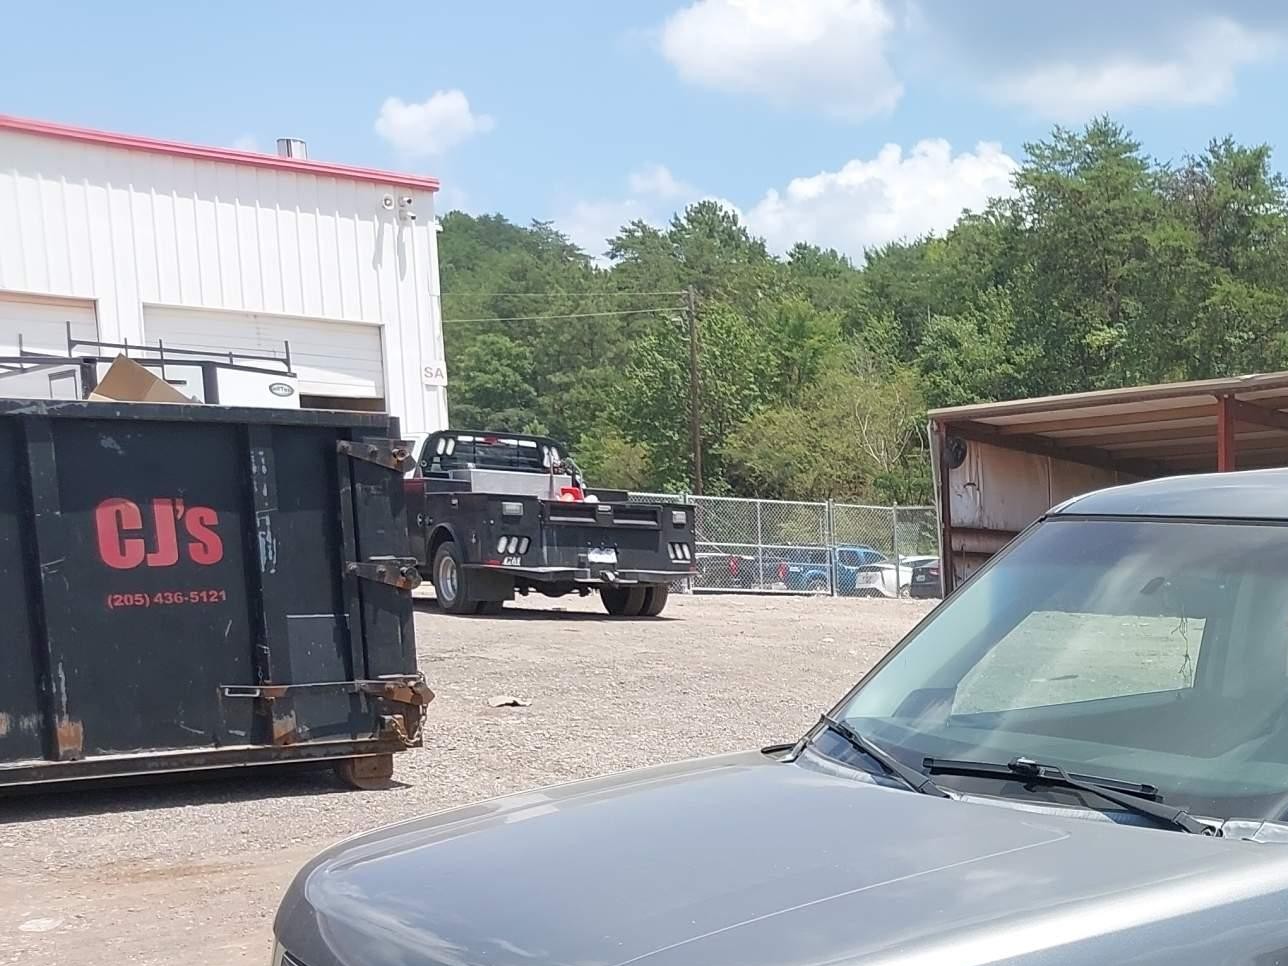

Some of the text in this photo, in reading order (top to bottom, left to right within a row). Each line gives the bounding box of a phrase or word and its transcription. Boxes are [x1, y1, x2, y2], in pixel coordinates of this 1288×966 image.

[423, 367, 445, 379] SA
[107, 590, 227, 608] (205) 436-5121
